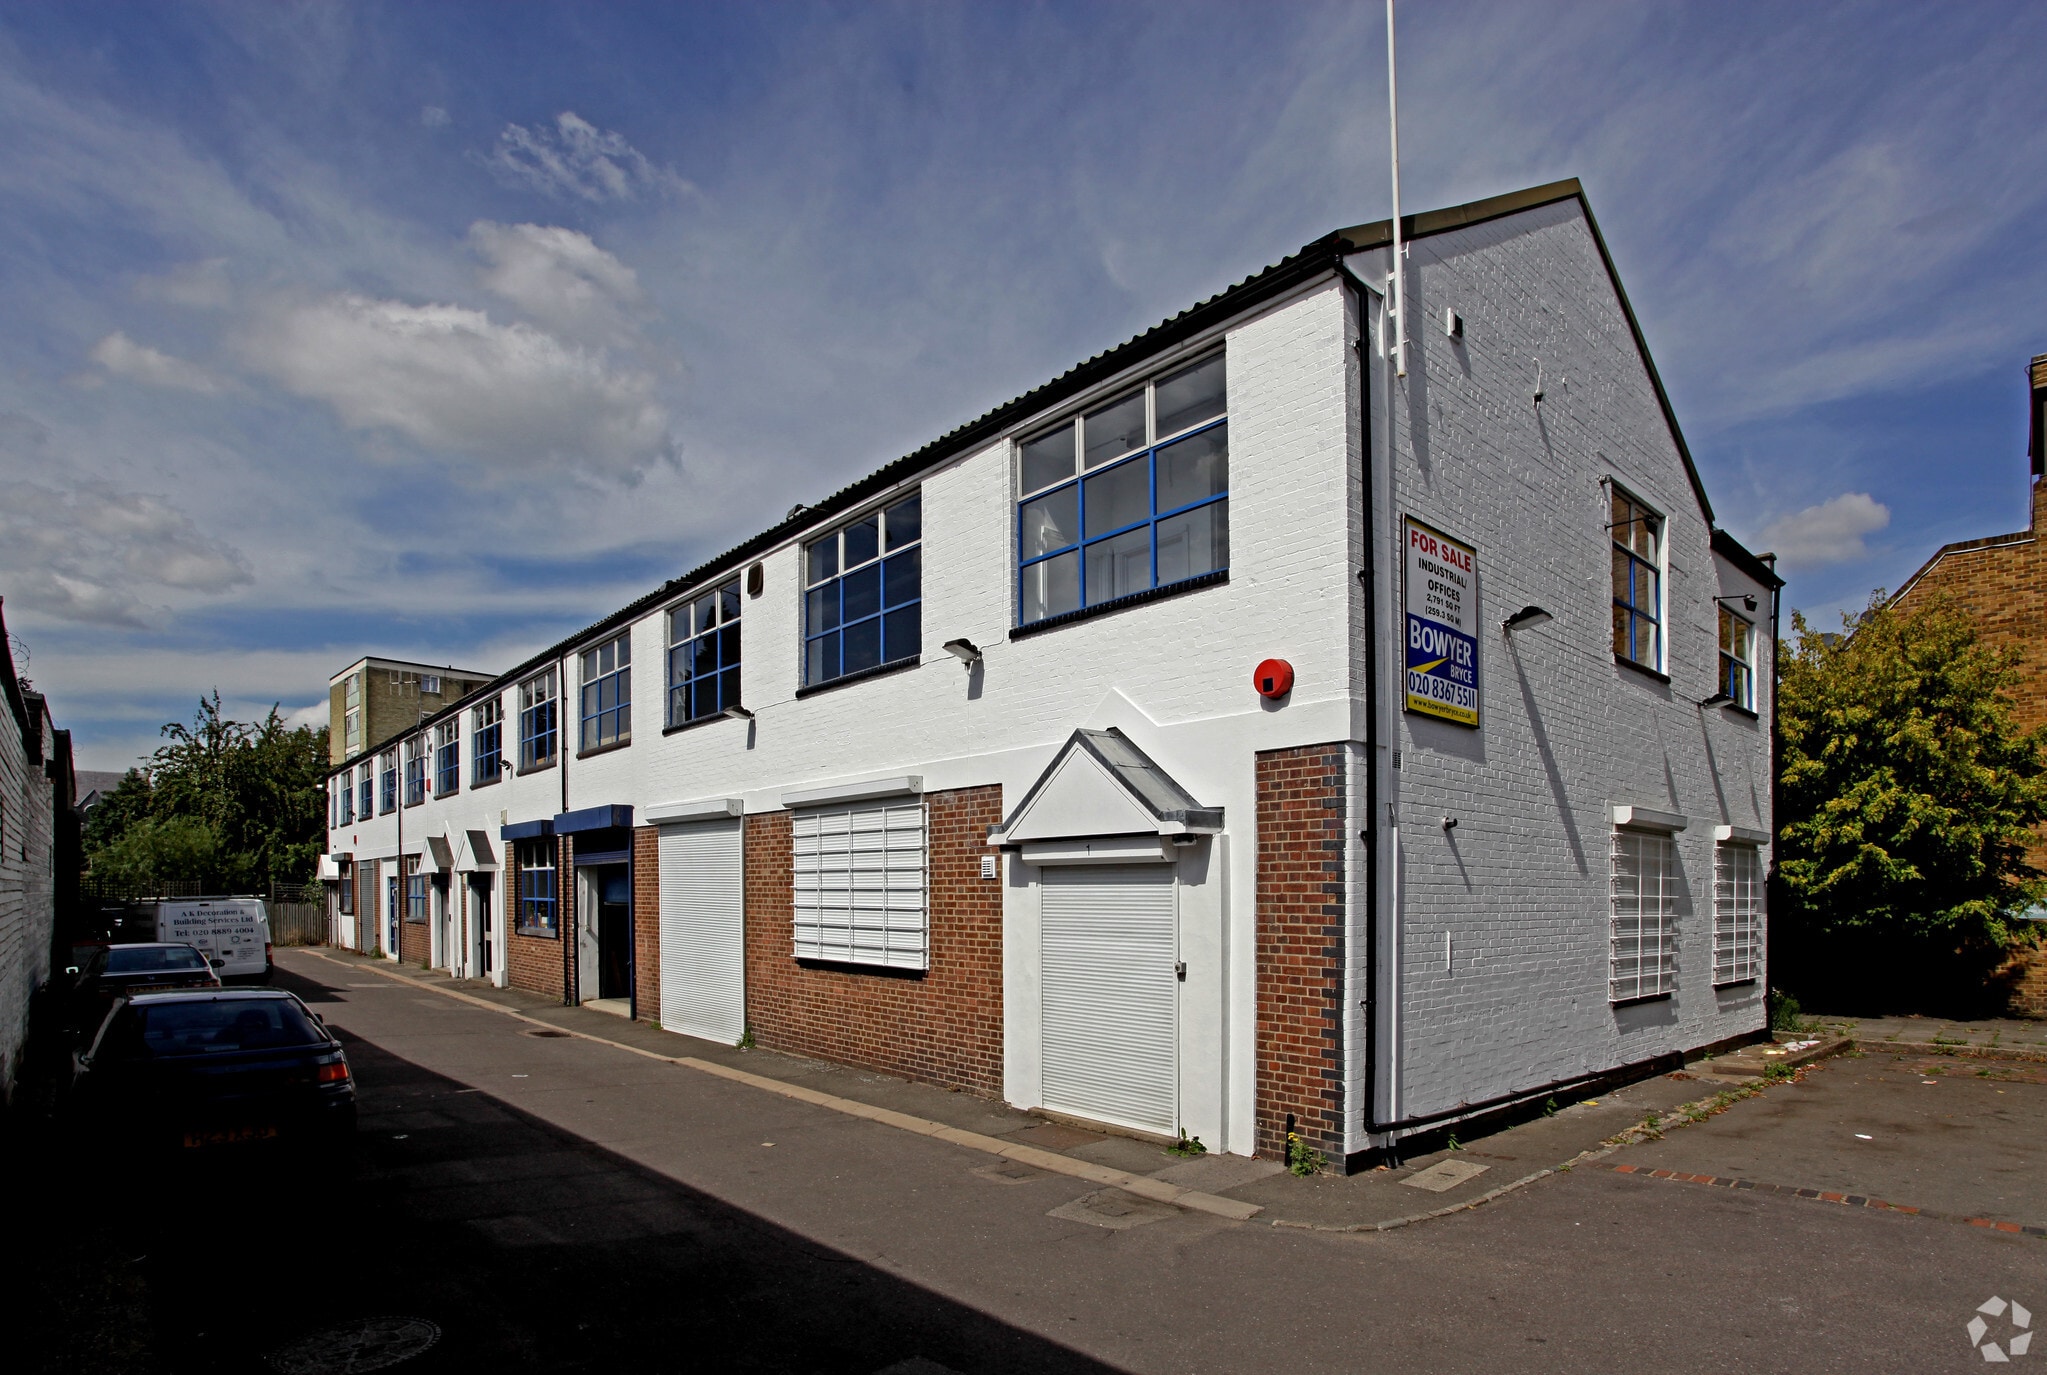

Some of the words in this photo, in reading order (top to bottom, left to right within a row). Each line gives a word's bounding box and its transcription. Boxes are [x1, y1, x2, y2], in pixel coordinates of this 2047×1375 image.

[1412, 530, 1438, 557] FOR
[1442, 544, 1471, 573] SALE
[1418, 557, 1468, 588] INDUSTRIAL/
[1428, 579, 1460, 602] OFFICES
[1426, 594, 1444, 608] 2,791
[1446, 600, 1454, 611] SQ
[1454, 603, 1461, 614] FT
[1425, 606, 1445, 619] (259.3
[1446, 613, 1454, 624] SQ
[1455, 616, 1462, 628] M)
[1410, 618, 1472, 668] BOWYER
[1450, 664, 1472, 684] BRYCE
[1409, 672, 1430, 695] 020
[1432, 679, 1456, 704] 8367
[1457, 690, 1474, 708] 5511
[1414, 698, 1471, 718] www.bowyerbryce.co.uk
[1086, 844, 1090, 856] 1
